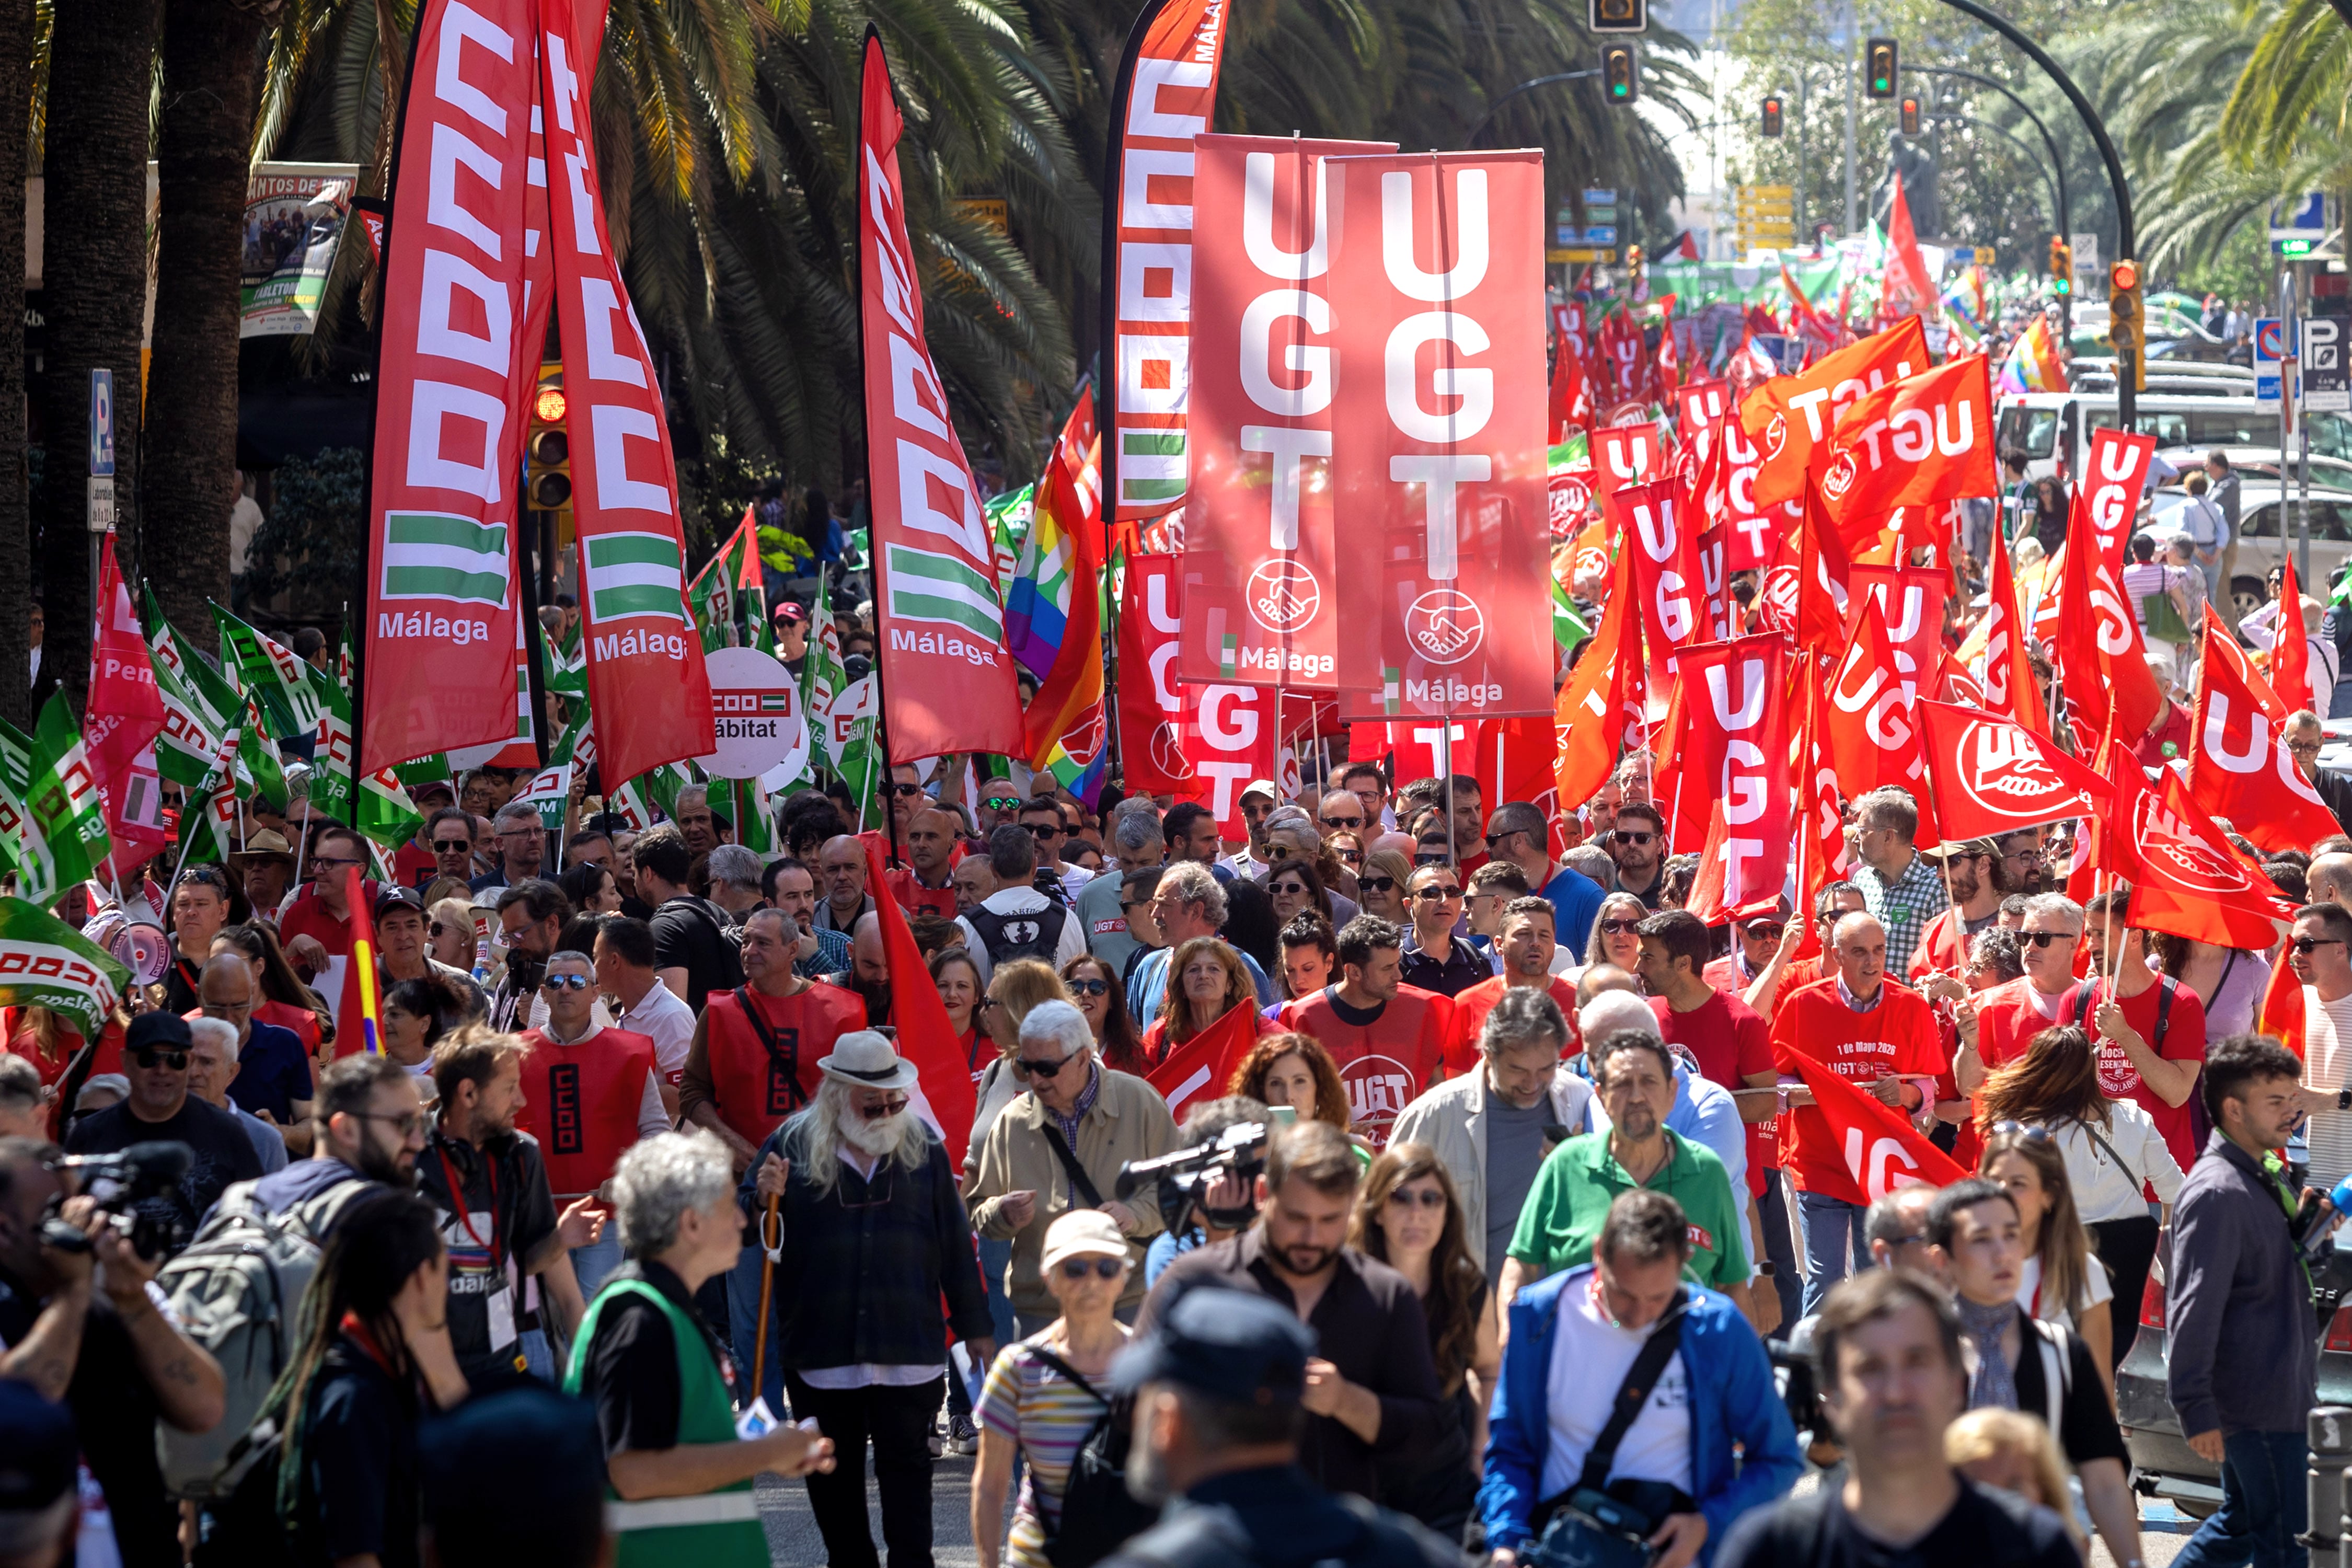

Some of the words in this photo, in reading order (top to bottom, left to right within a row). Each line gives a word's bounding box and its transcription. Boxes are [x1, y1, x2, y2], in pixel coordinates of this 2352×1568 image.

[298, 178, 318, 193] DE
[1117, 57, 1214, 414] CCOO
[1240, 152, 1346, 550] UGT
[2304, 320, 2339, 371] P
[1381, 168, 1494, 580] UGT
[1633, 499, 1693, 674] UG
[378, 611, 489, 645] Málaga
[1241, 646, 1334, 678] Málaga
[1405, 679, 1503, 708] Málaga
[716, 719, 777, 739] ábitat
[1704, 659, 1768, 907] UGT
[1094, 920, 1115, 932] UGT
[1837, 1045, 1843, 1056] 1
[1843, 1043, 1854, 1054] de
[1855, 1041, 1876, 1053] Mayo
[1877, 1042, 1896, 1056] 2026
[772, 1033, 792, 1110] COO
[1342, 1074, 1408, 1114] UGT
[555, 1068, 576, 1147] CCOO
